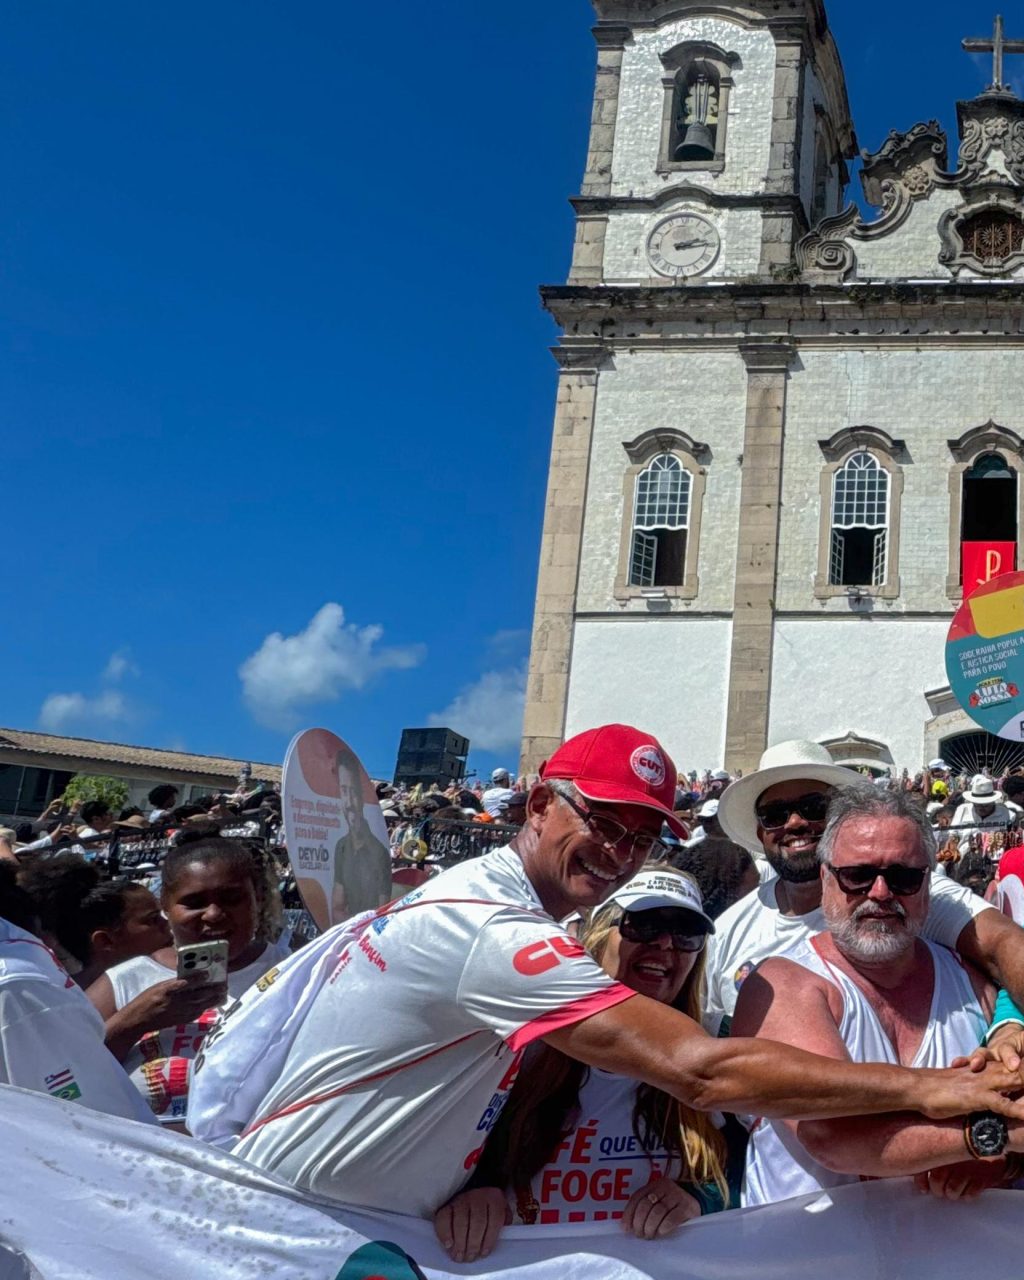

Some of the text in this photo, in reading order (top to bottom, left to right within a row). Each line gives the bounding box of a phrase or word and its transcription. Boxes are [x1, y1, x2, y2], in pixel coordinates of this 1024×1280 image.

[994, 649, 1018, 661] SOCIAL
[963, 667, 982, 679] PARA
[988, 662, 1007, 672] POVO
[639, 757, 662, 775] CUT
[512, 936, 585, 976] CU
[599, 1135, 636, 1154] QUE
[541, 1168, 633, 1203] FOGE
